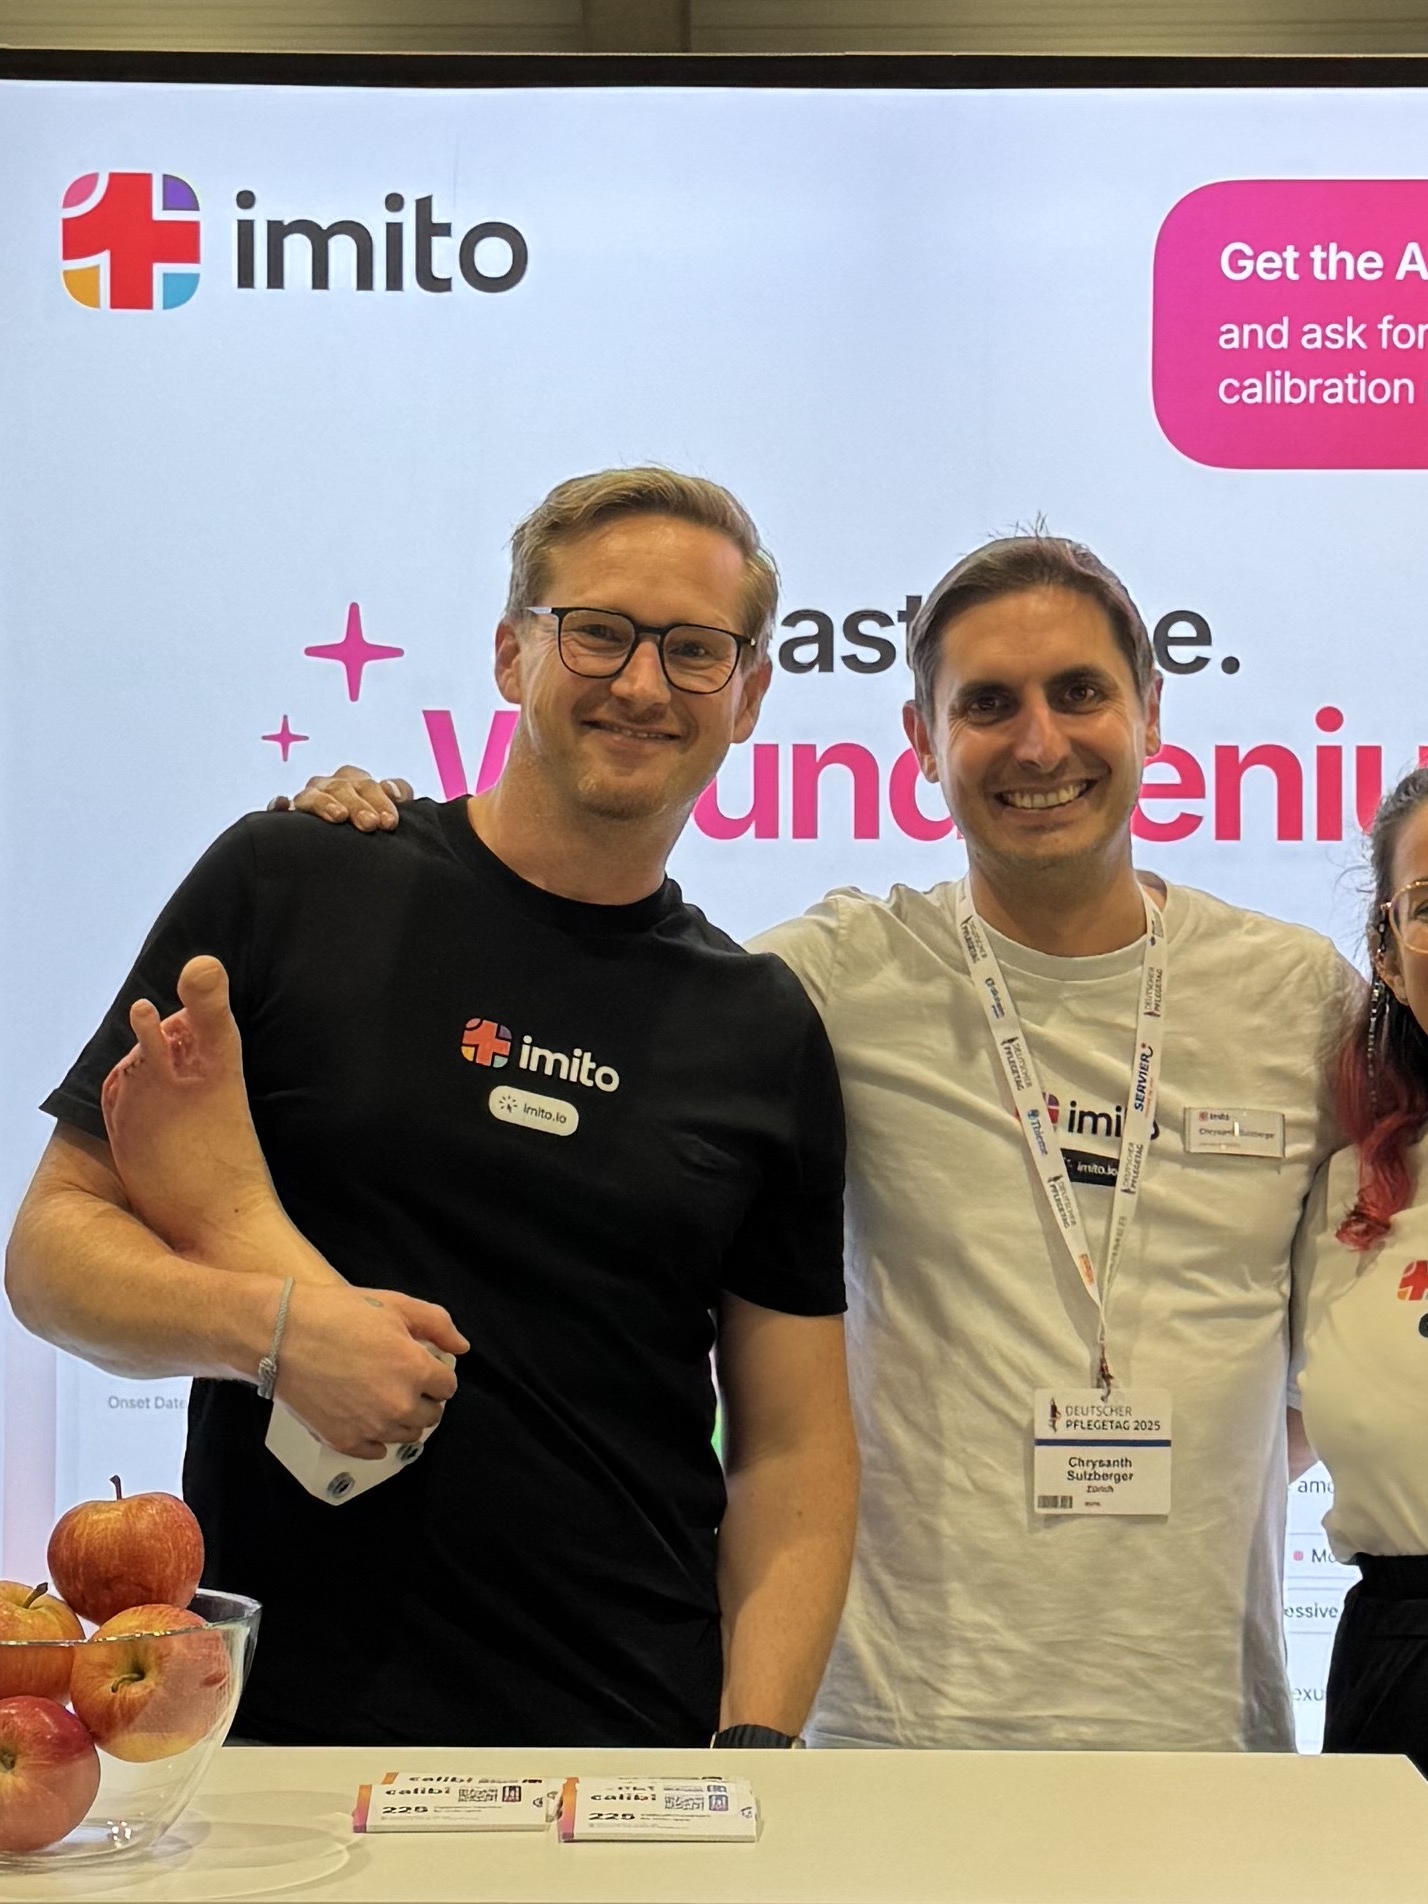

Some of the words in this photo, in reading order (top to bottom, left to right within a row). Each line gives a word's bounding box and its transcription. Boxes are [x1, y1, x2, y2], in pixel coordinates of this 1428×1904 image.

[236, 190, 528, 293] imito
[1221, 242, 1299, 280] Get
[1310, 243, 1383, 280] the
[1219, 317, 1288, 349] and
[1301, 316, 1367, 349] ask
[1219, 370, 1414, 403] calibration
[518, 1034, 621, 1093] imito
[1134, 1050, 1152, 1113] SERVIER
[1068, 1100, 1160, 1140] imi
[108, 1395, 150, 1409] Onset
[1065, 1406, 1132, 1416] DEUTSCHER
[1066, 1420, 1130, 1430] PFLEGETAG
[1133, 1420, 1161, 1431] 2025
[1067, 1470, 1134, 1484] Sulzberger
[1068, 1457, 1133, 1470] Chrysanth
